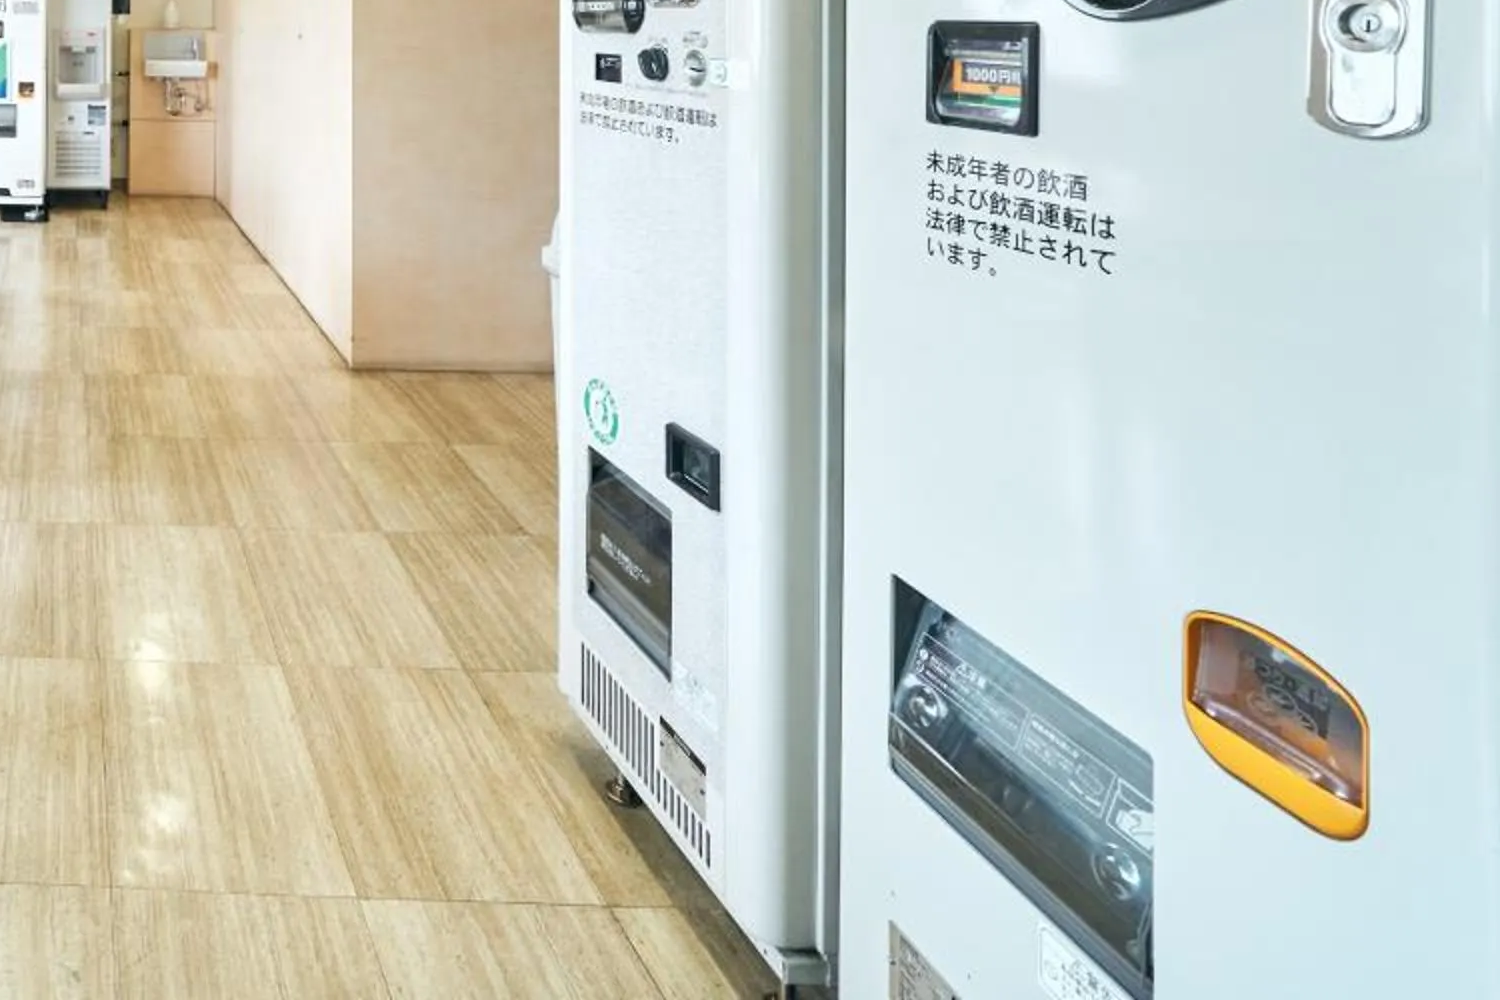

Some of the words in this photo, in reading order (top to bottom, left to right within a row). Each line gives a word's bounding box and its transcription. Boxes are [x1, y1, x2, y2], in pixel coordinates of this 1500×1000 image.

[926, 149, 1088, 201] 未成年者の飲酒
[927, 179, 1116, 240] および飲酒運転は
[926, 207, 1117, 275] 法律で禁止されて
[927, 236, 997, 277] います。
